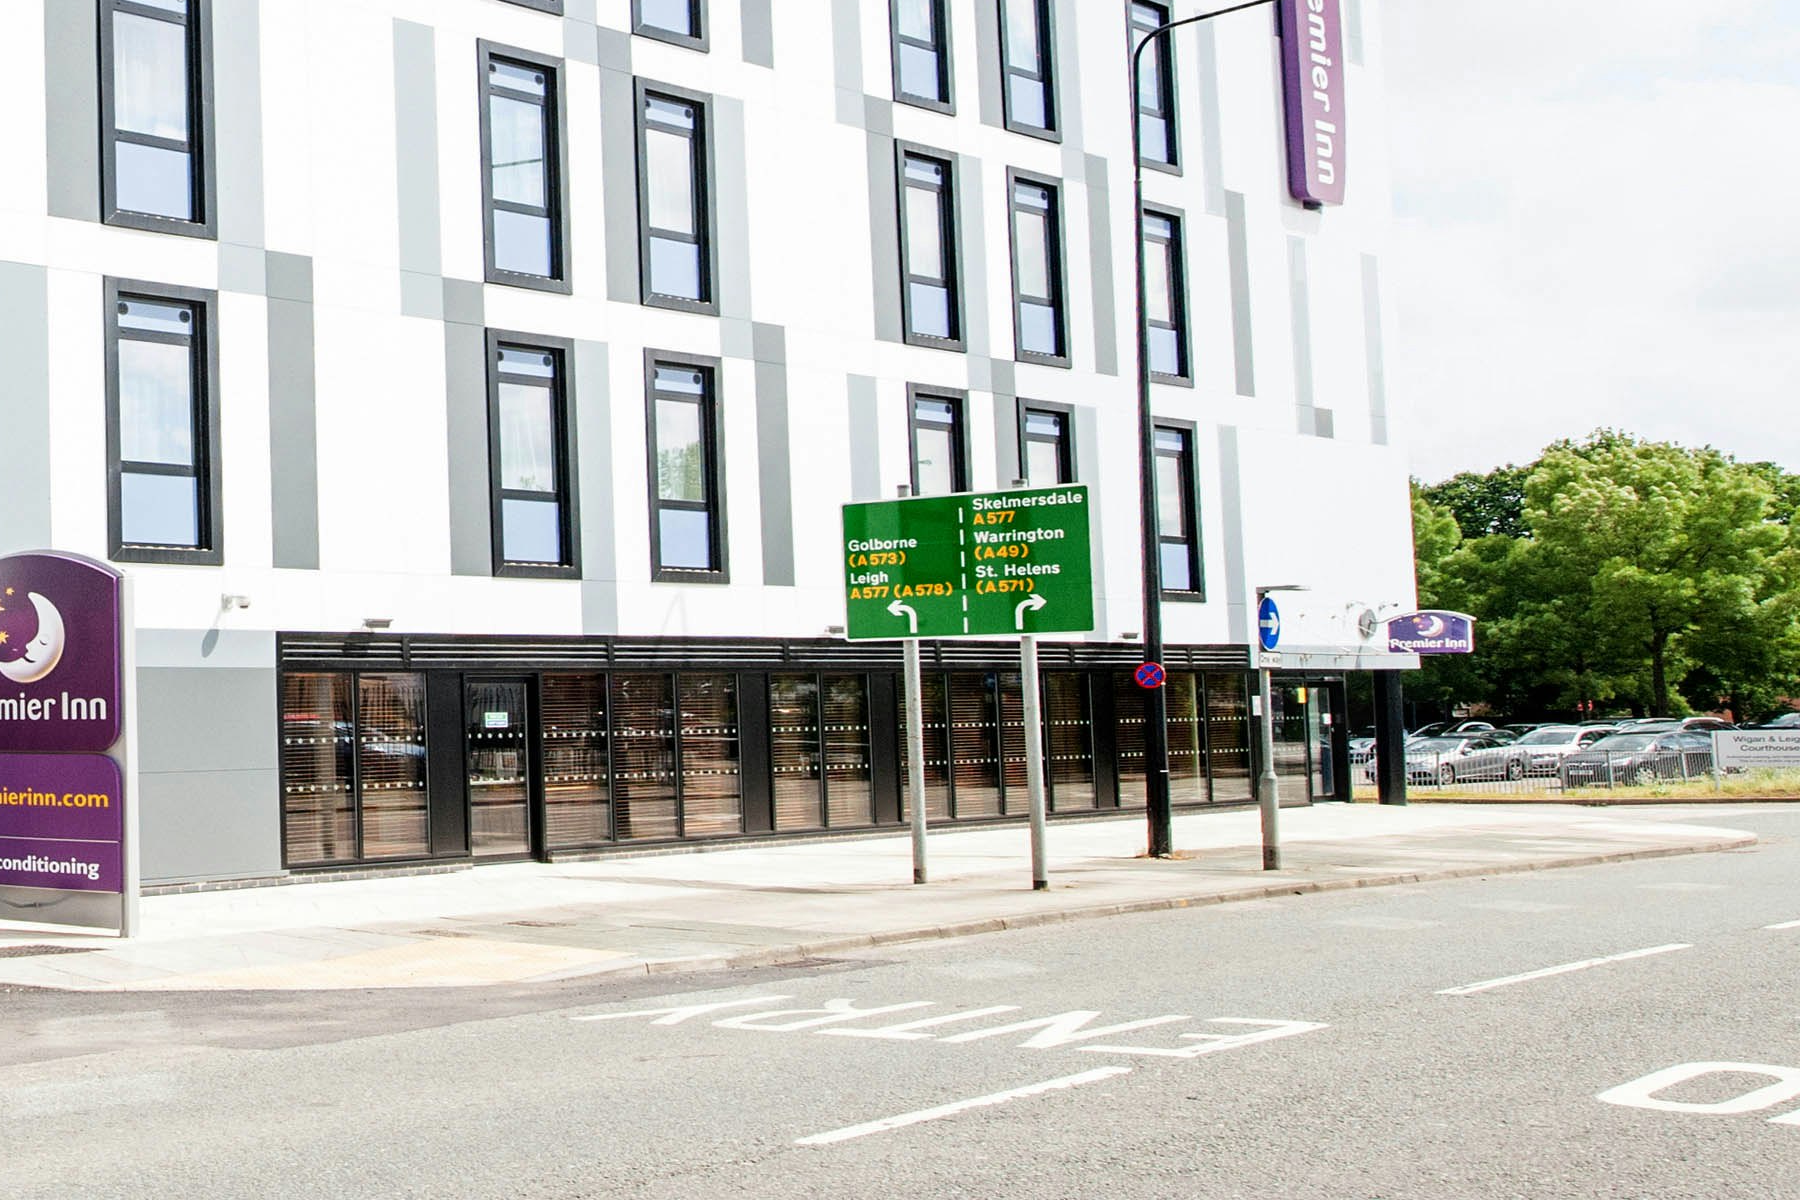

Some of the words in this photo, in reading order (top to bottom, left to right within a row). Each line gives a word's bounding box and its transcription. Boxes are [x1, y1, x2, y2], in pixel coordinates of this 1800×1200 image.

[1314, 118, 1336, 185] Inn
[972, 491, 1083, 511] Skelmersdale
[973, 510, 1016, 525] A577
[973, 527, 1065, 544] Warrington
[848, 538, 918, 552] Golborne
[975, 565, 998, 578] St.
[1004, 562, 1061, 577] Helens
[850, 571, 889, 586] Leigh
[850, 585, 890, 600] A577
[1390, 638, 1444, 649] Premier
[1444, 638, 1467, 650] Inn
[61, 691, 107, 721] Inn
[570, 995, 1329, 1057] ENTRY
[1596, 1061, 1800, 1126] O
